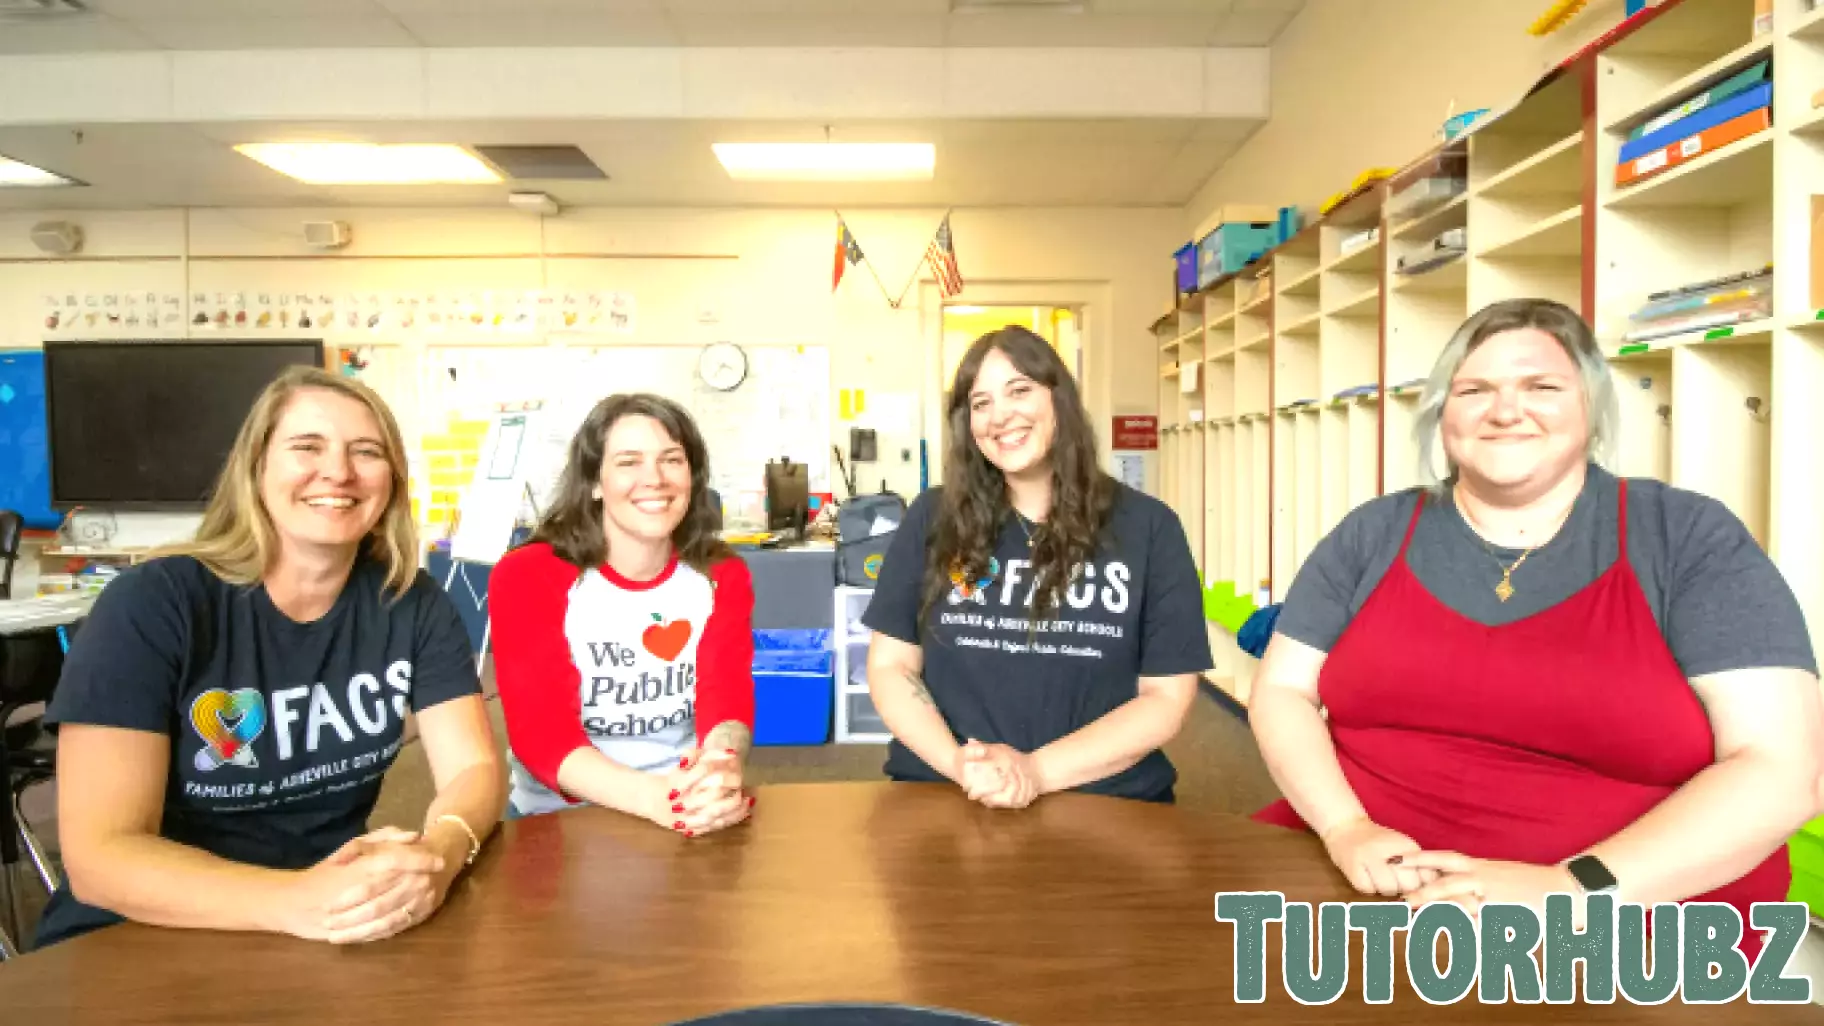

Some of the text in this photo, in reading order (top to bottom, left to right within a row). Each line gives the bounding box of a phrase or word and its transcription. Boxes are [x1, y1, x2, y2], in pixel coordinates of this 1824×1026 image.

[587, 642, 635, 667] We
[271, 658, 412, 760] FACS
[583, 698, 695, 736] School
[184, 780, 254, 797] FAMILIES
